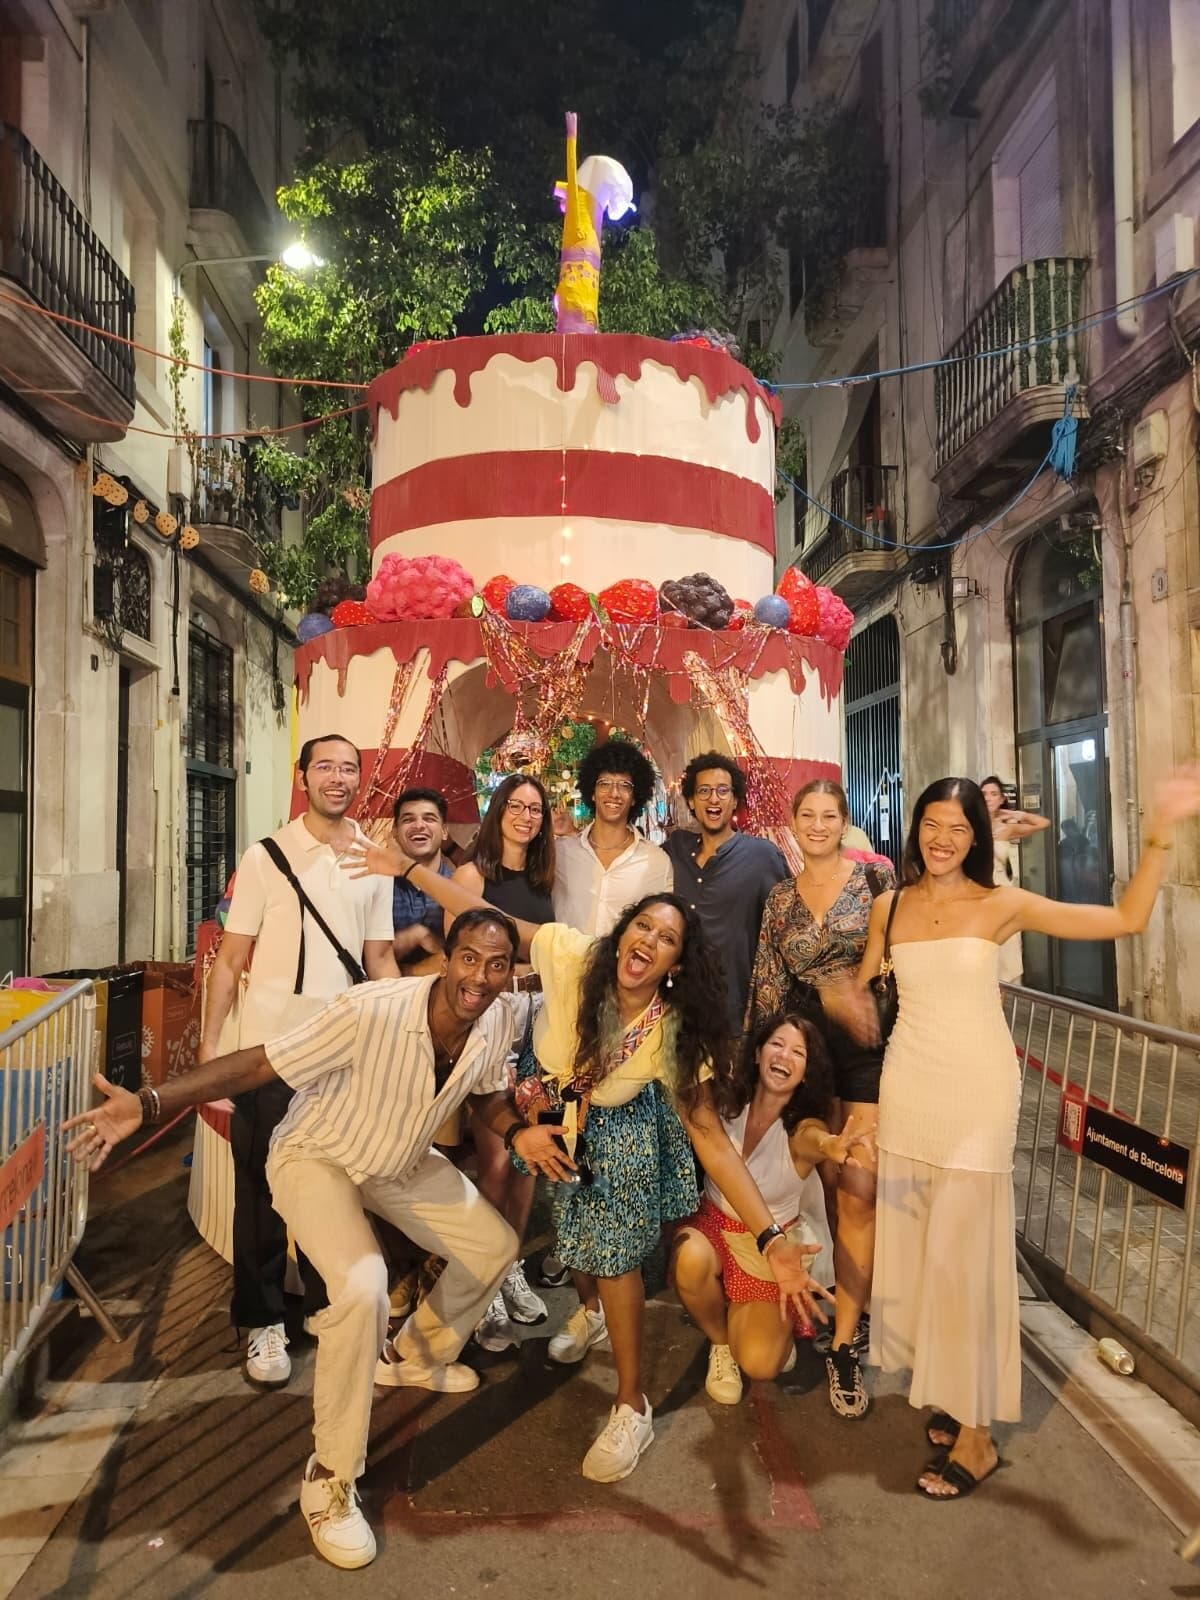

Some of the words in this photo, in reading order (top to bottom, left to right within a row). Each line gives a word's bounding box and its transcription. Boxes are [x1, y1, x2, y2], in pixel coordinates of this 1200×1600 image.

[1086, 1126, 1128, 1157] Ajuntament
[1128, 1147, 1139, 1162] de
[1140, 1152, 1184, 1185] Barcelona
